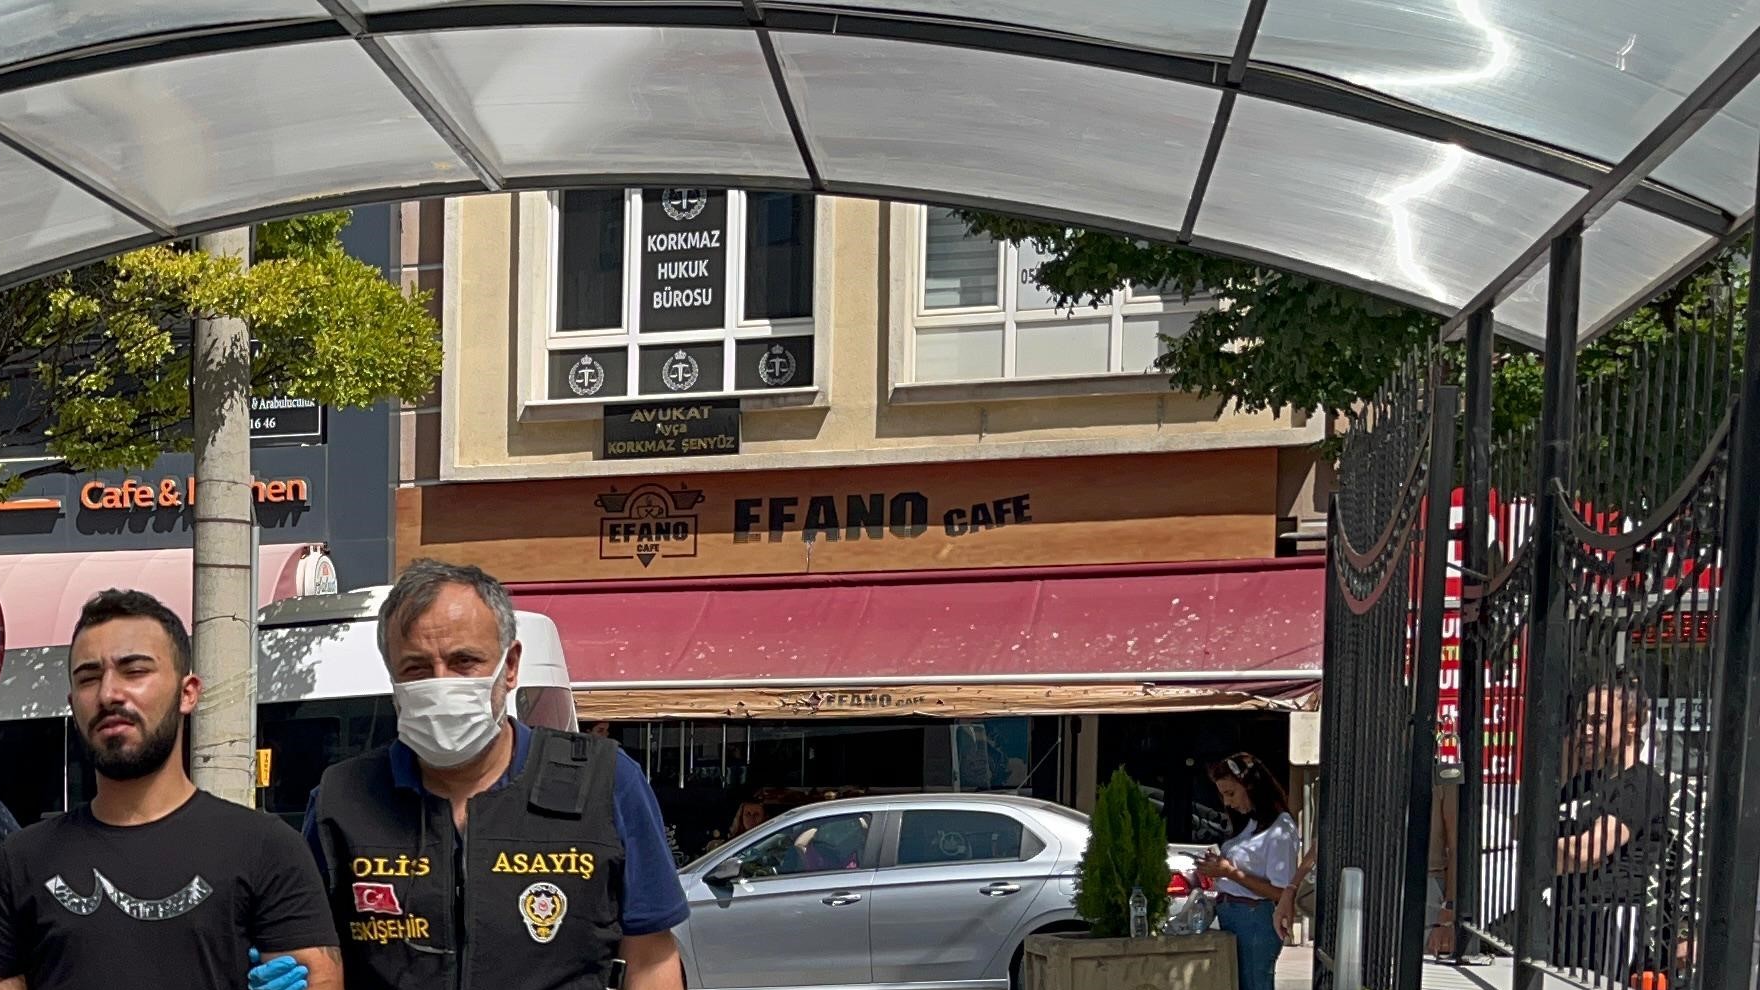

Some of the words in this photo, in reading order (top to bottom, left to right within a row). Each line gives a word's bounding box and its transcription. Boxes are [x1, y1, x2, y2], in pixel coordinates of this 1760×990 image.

[647, 230, 720, 252] KORKMAZ
[658, 259, 709, 280] HUKUK
[653, 286, 712, 309] BÜROSU
[630, 405, 713, 423] AVUKAT
[607, 439, 676, 455] KORKMAZ
[681, 434, 735, 453] ŞENYÜZ
[81, 479, 155, 510] Cafe
[158, 478, 182, 507] &
[733, 492, 929, 544] EFANO
[943, 493, 1033, 538] CAFE
[609, 520, 689, 543] EFANO
[636, 543, 660, 553] CAFE
[352, 854, 431, 877] OLİS
[491, 847, 595, 880] ASAYİŞ
